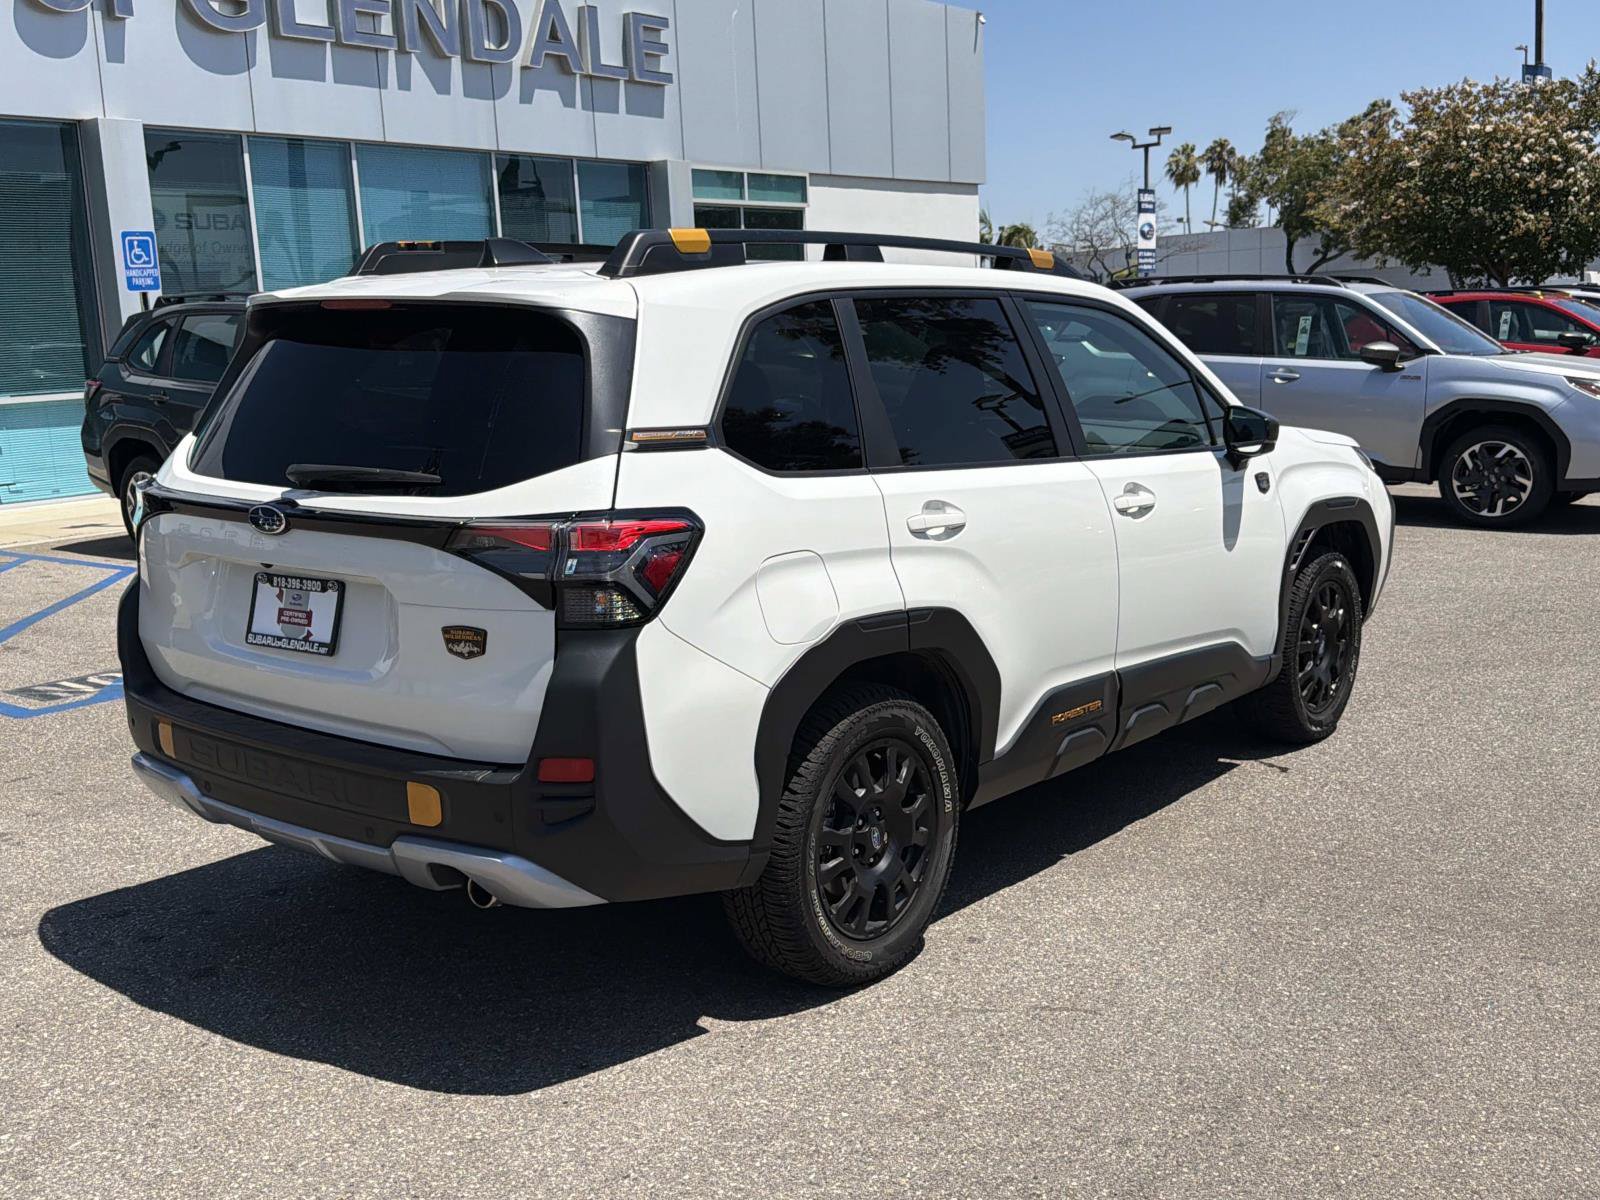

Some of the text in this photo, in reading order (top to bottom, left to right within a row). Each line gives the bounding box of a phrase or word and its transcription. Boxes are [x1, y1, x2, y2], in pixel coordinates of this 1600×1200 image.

[126, 268, 159, 277] HANDICAPPED
[132, 277, 154, 287] PARKING
[283, 610, 307, 618] CERTIFIED
[281, 616, 308, 625] PRE-OWNED
[1051, 700, 1102, 726] FORESTER
[914, 725, 953, 813] YOKOHAMA
